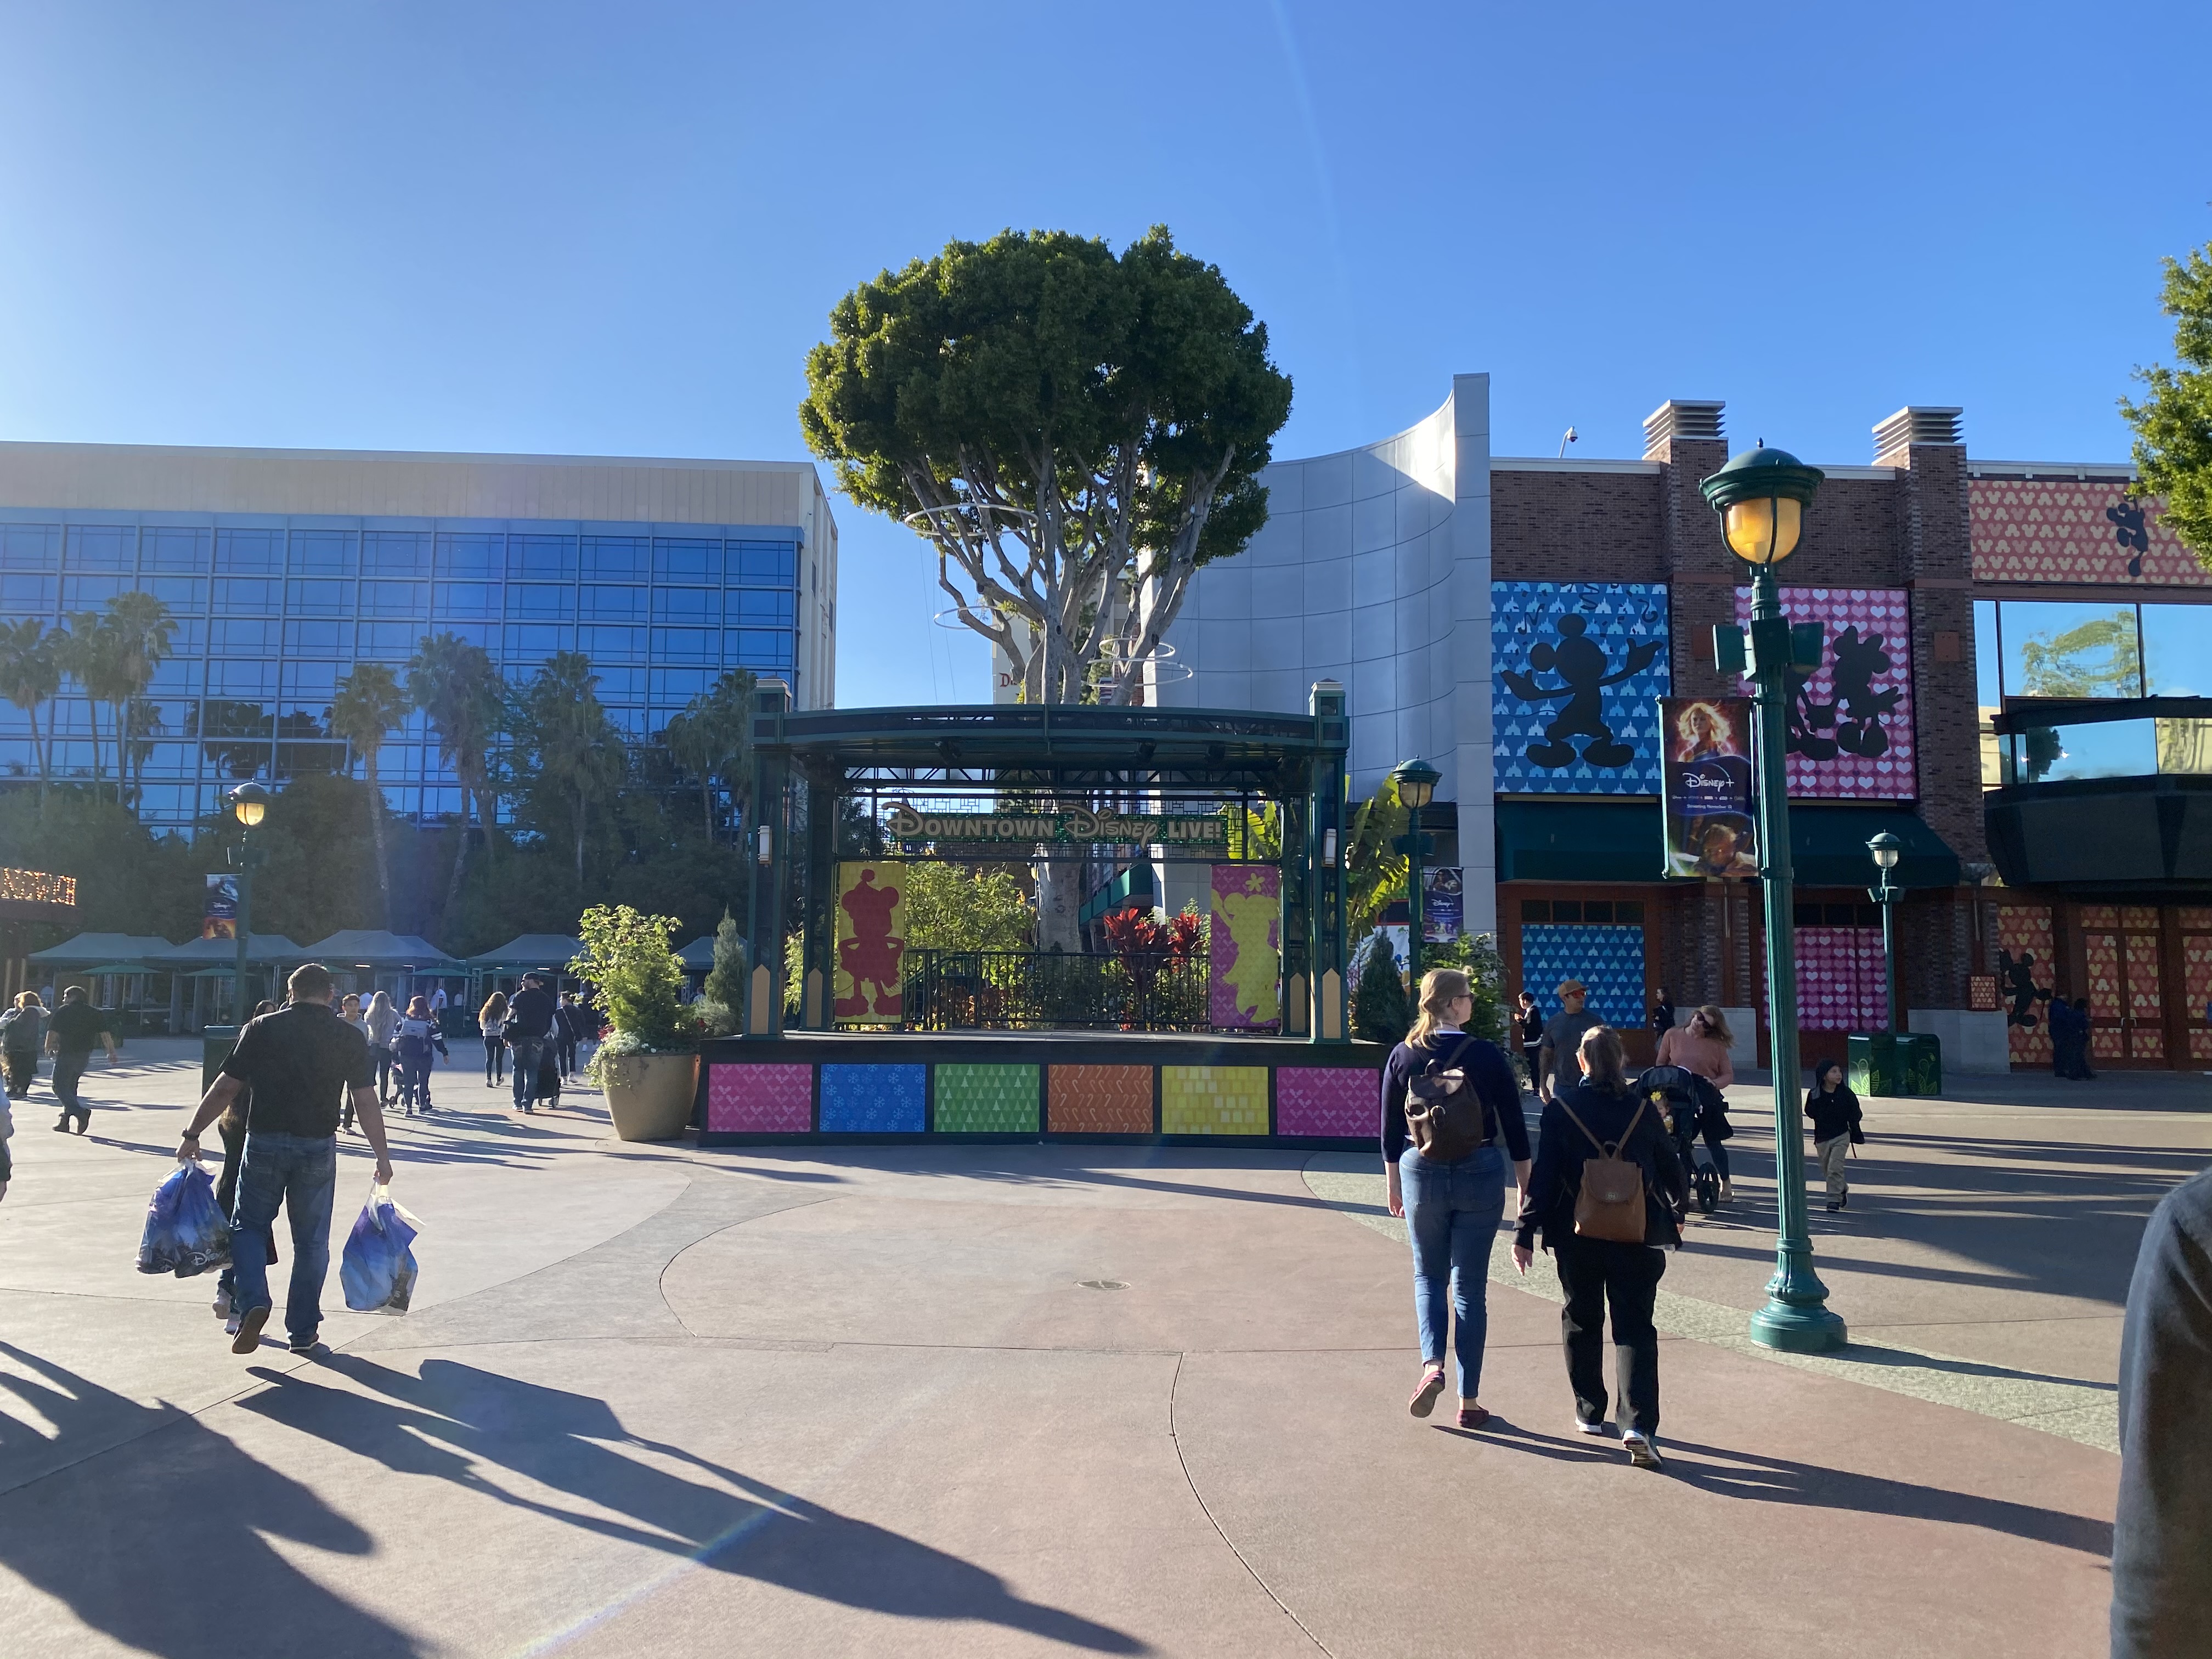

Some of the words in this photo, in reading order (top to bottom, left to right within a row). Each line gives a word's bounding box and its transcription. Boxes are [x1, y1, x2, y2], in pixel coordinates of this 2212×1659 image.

[1682, 772, 1735, 792] Disney+
[1059, 804, 1158, 849] Disney
[1168, 821, 1222, 839] LIVE!
